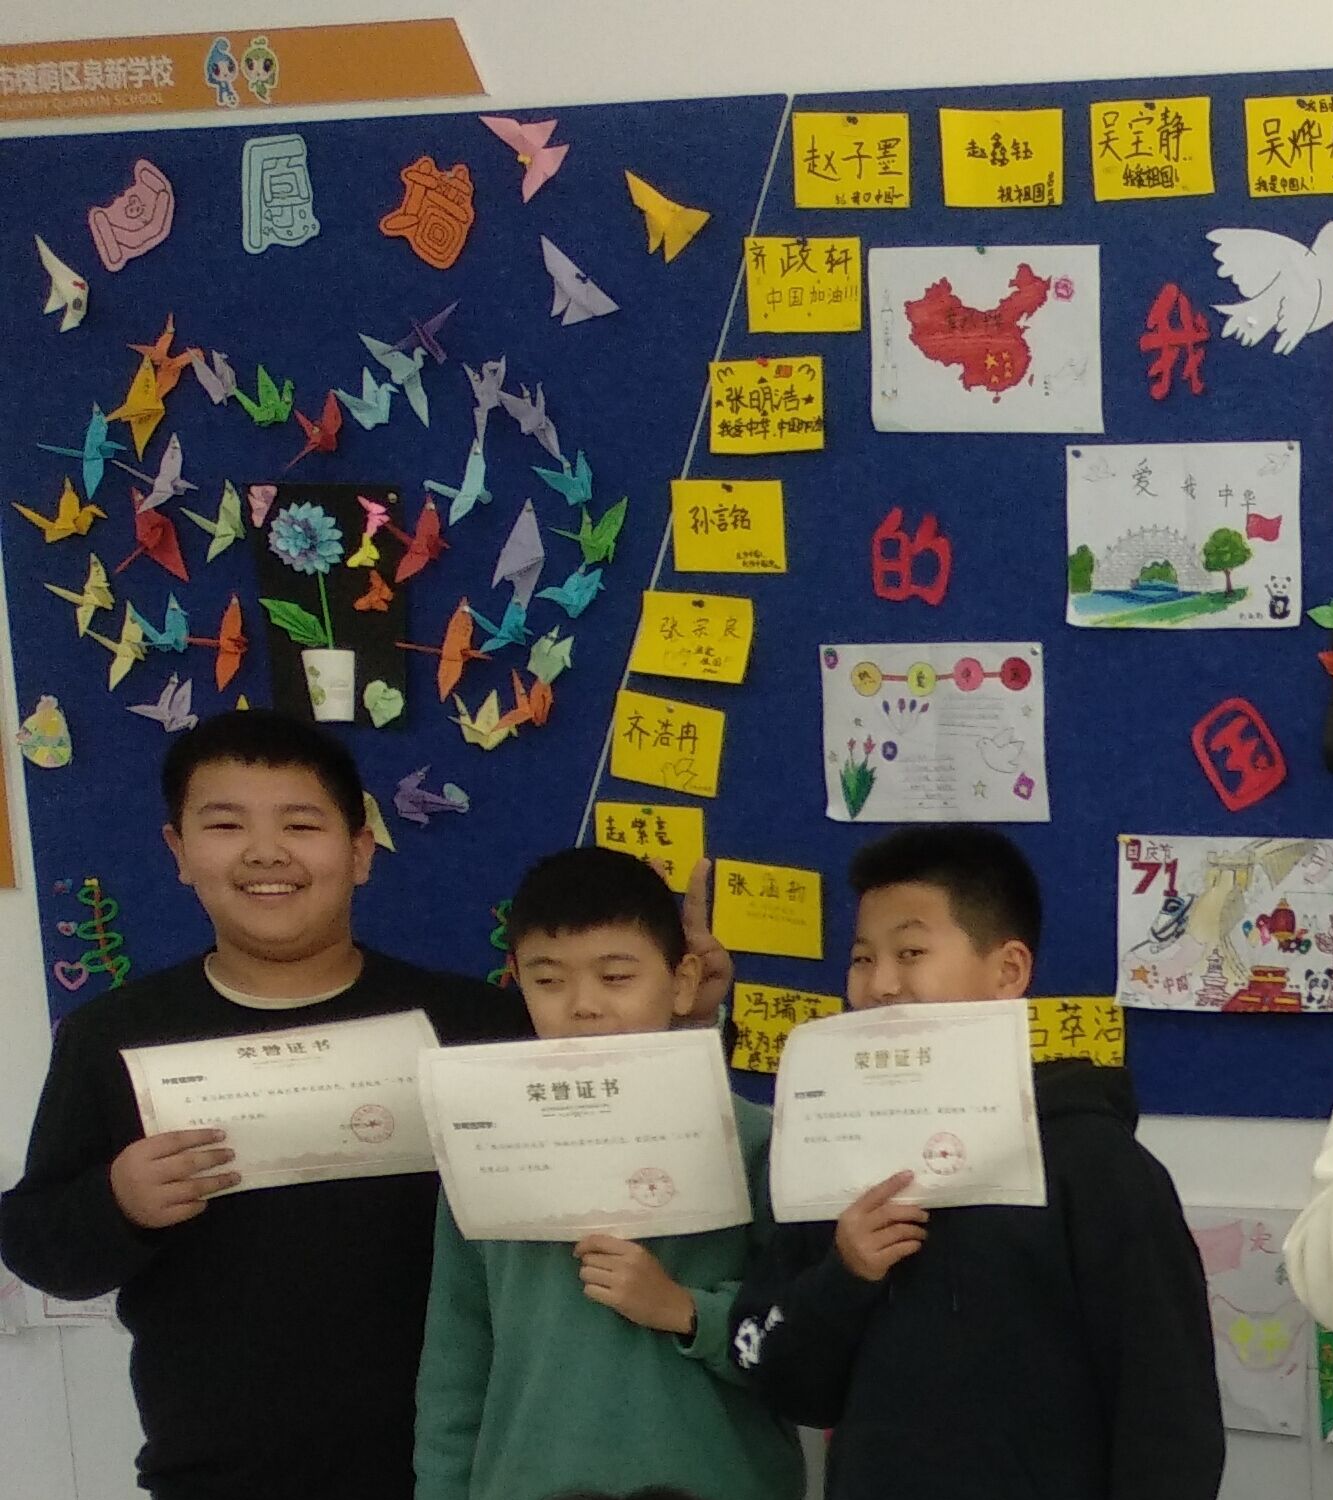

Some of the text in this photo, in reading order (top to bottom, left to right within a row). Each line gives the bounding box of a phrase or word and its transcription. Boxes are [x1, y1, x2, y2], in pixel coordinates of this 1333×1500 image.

[802, 134, 904, 181] 赵子墨
[749, 240, 853, 277] 齐政轩
[1140, 282, 1211, 400] 我
[725, 384, 800, 414] 张明浩
[871, 507, 953, 606] 的
[660, 616, 741, 640] 张宗良
[622, 709, 699, 755] 齐浩冉
[1130, 860, 1180, 898] 71
[855, 1047, 931, 1069] 荣誉证书
[527, 1078, 621, 1102] 荣誉证书
